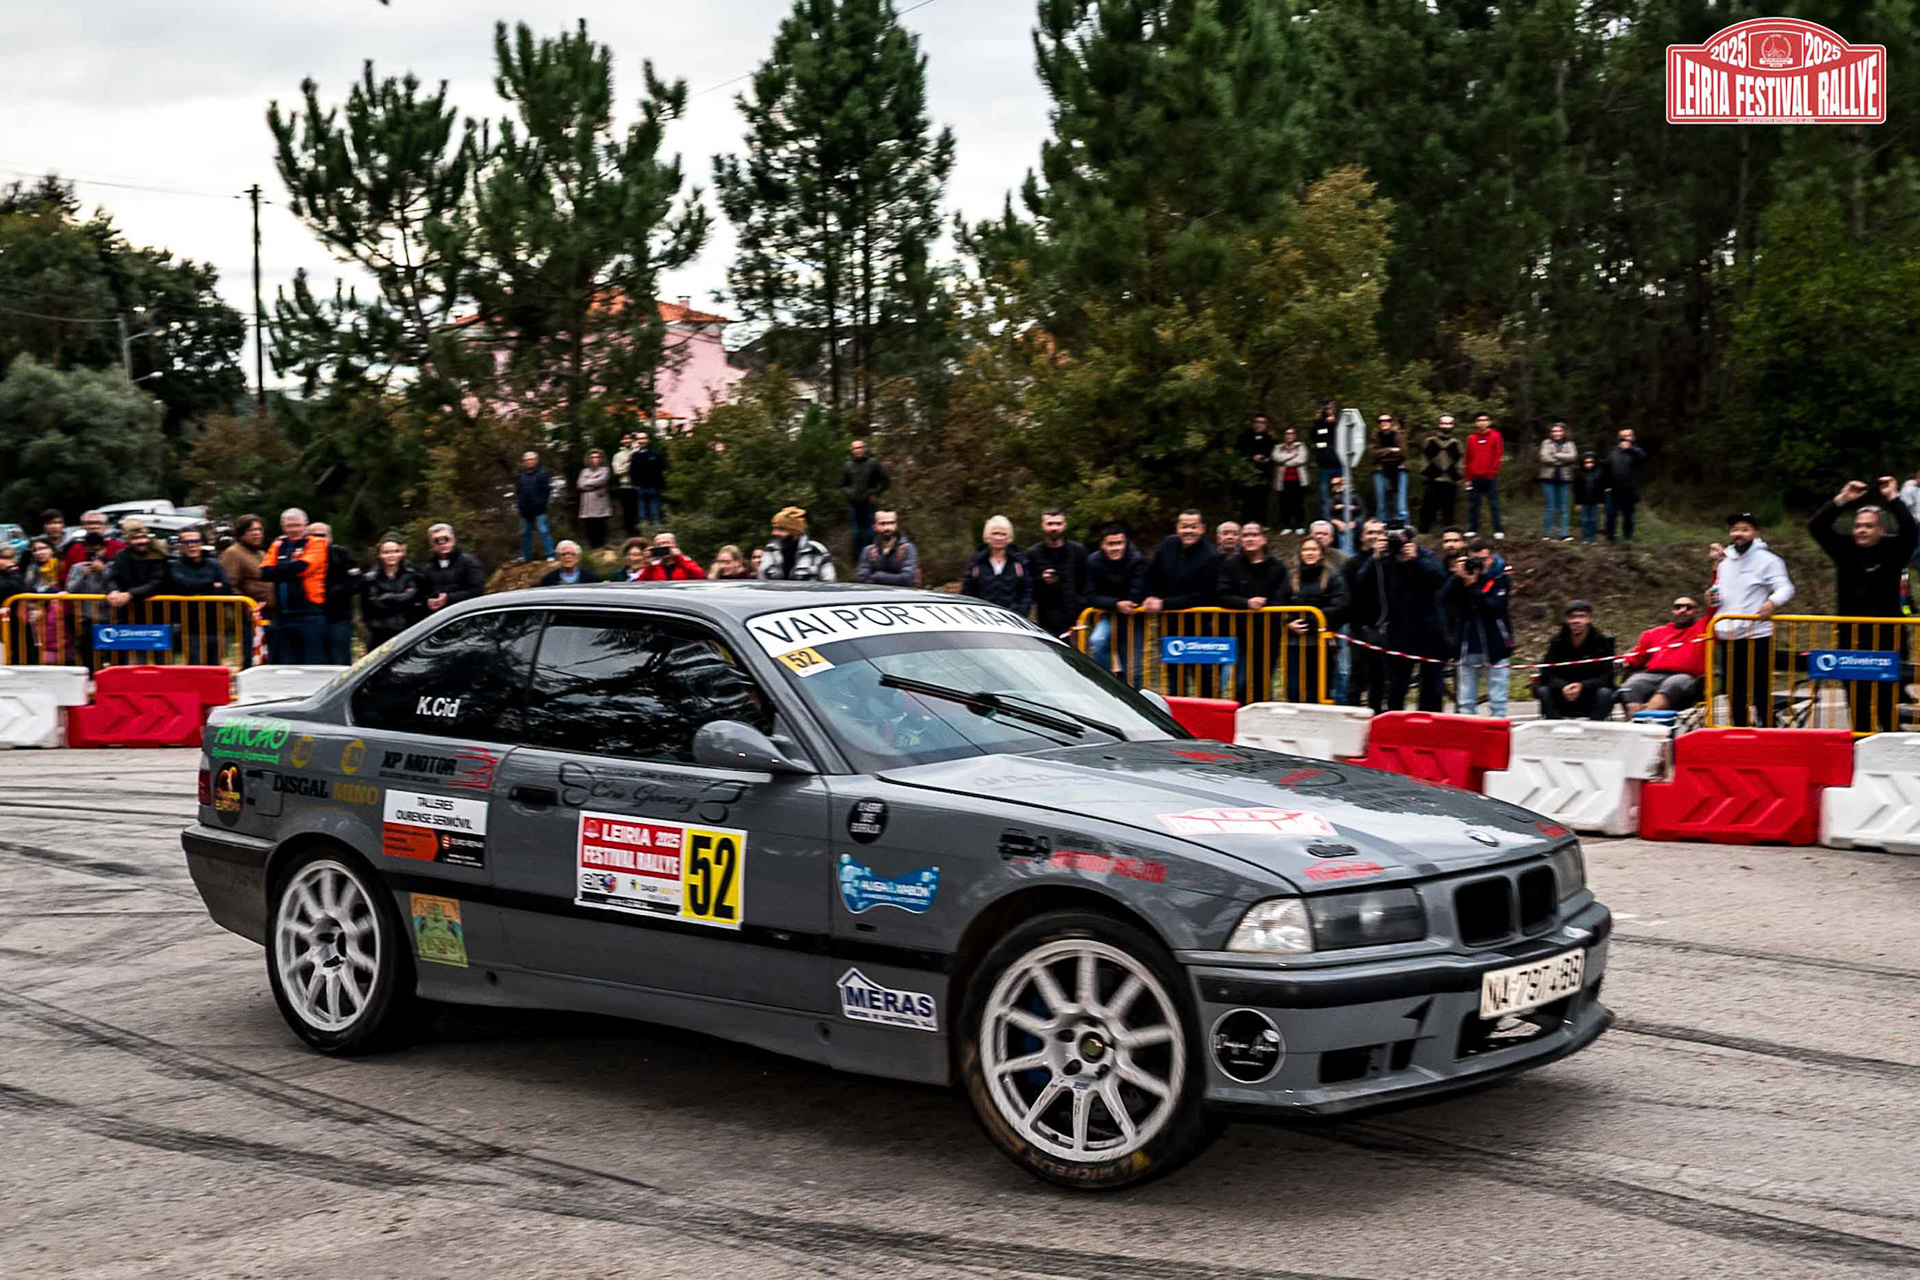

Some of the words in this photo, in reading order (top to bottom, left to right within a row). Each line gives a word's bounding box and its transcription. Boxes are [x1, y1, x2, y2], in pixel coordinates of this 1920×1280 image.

[754, 613, 836, 644] VAI
[830, 605, 924, 630] POR
[919, 605, 958, 625] TI
[785, 651, 821, 668] 52
[416, 696, 461, 717] K.Cid
[403, 753, 458, 776] MOTOR
[272, 774, 329, 799] DISGAL
[417, 796, 454, 811] TALLERES
[396, 810, 432, 825] OURENSE
[602, 824, 652, 847] LEIRIA
[654, 831, 681, 848] 2025
[583, 845, 635, 869] FESTIVAL
[636, 851, 680, 875] RALLYE
[689, 834, 736, 920] 52
[845, 986, 932, 1018] MERAS
